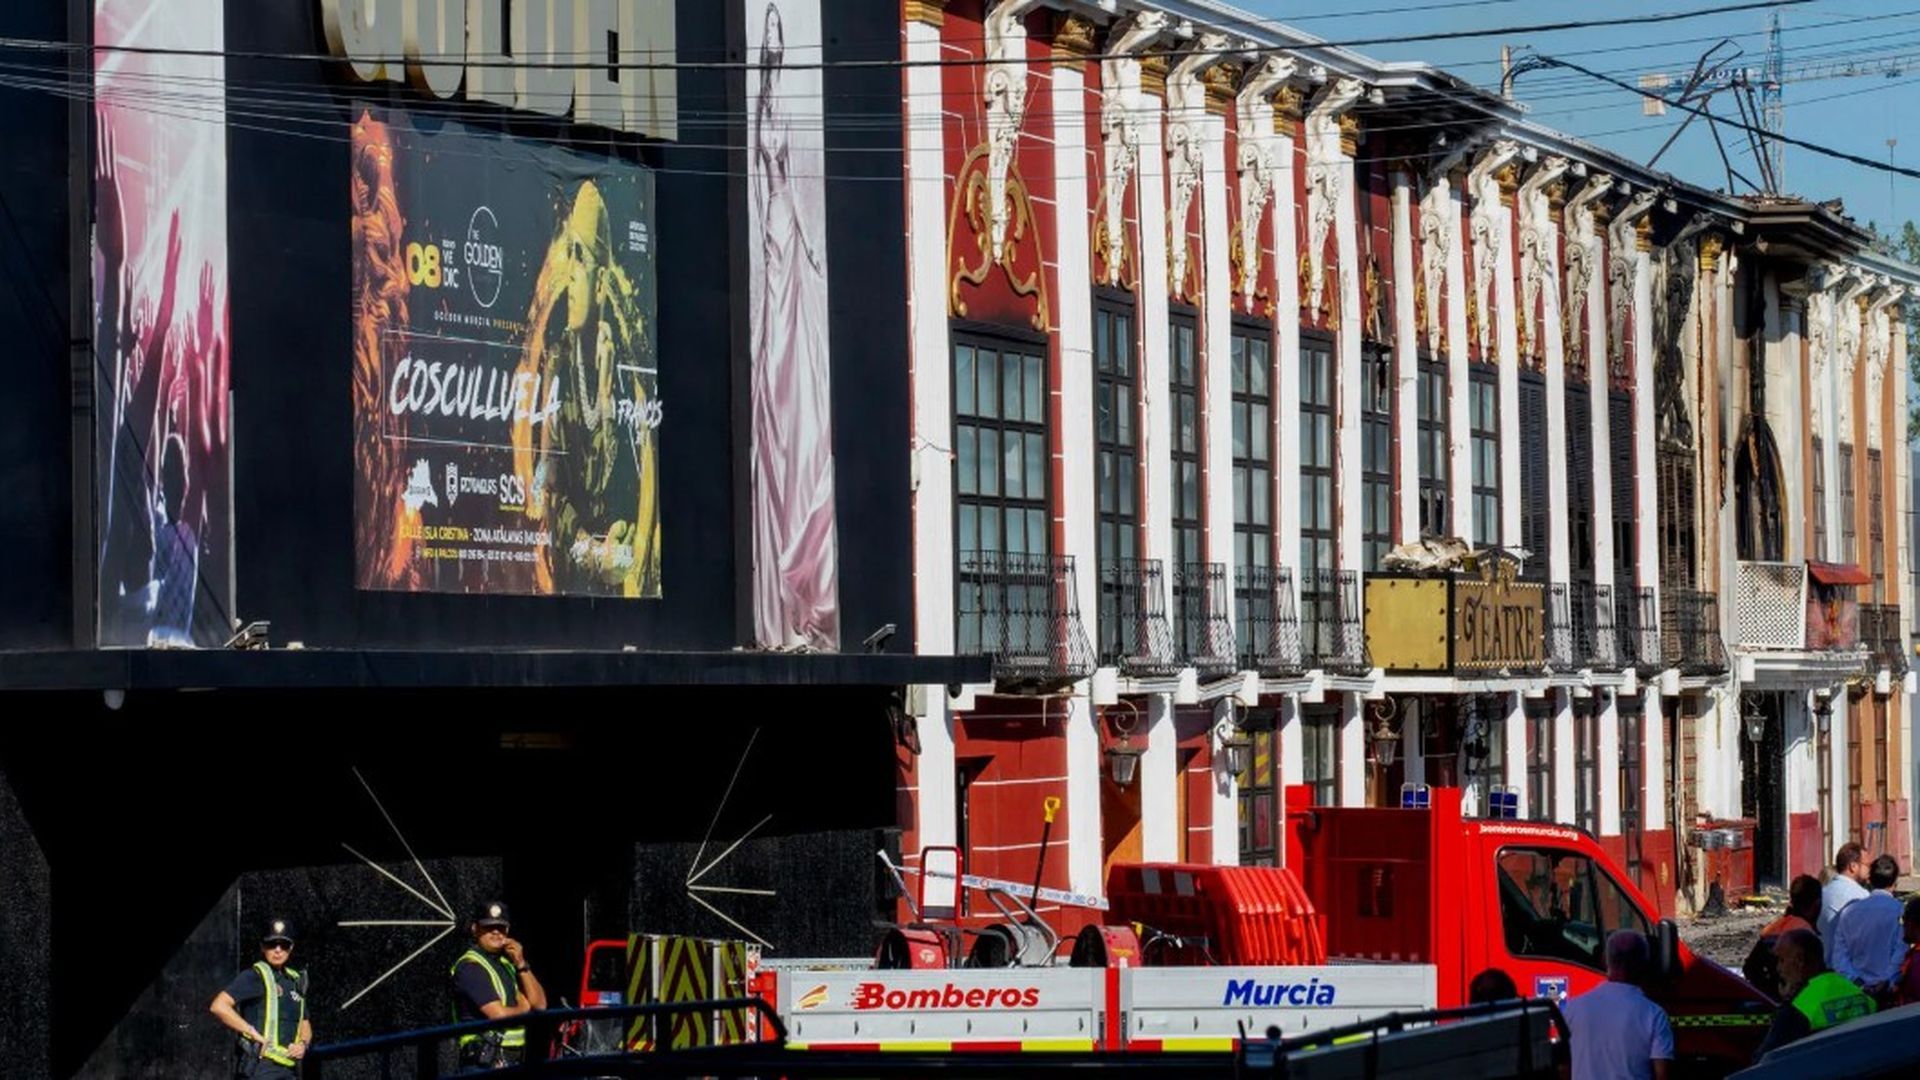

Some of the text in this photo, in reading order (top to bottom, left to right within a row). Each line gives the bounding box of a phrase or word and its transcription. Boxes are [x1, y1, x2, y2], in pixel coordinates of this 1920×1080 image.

[406, 242, 441, 288] 08
[464, 242, 503, 269] GOLDEN
[443, 267, 460, 288] DIC
[389, 357, 562, 424] COSCULLUELA
[500, 473, 525, 504] SCS
[1463, 590, 1537, 662] TEATRE
[1479, 822, 1579, 841] bomberosmurcia.org
[852, 983, 1040, 1010] Bomberos
[1223, 978, 1336, 1006] Murcia
